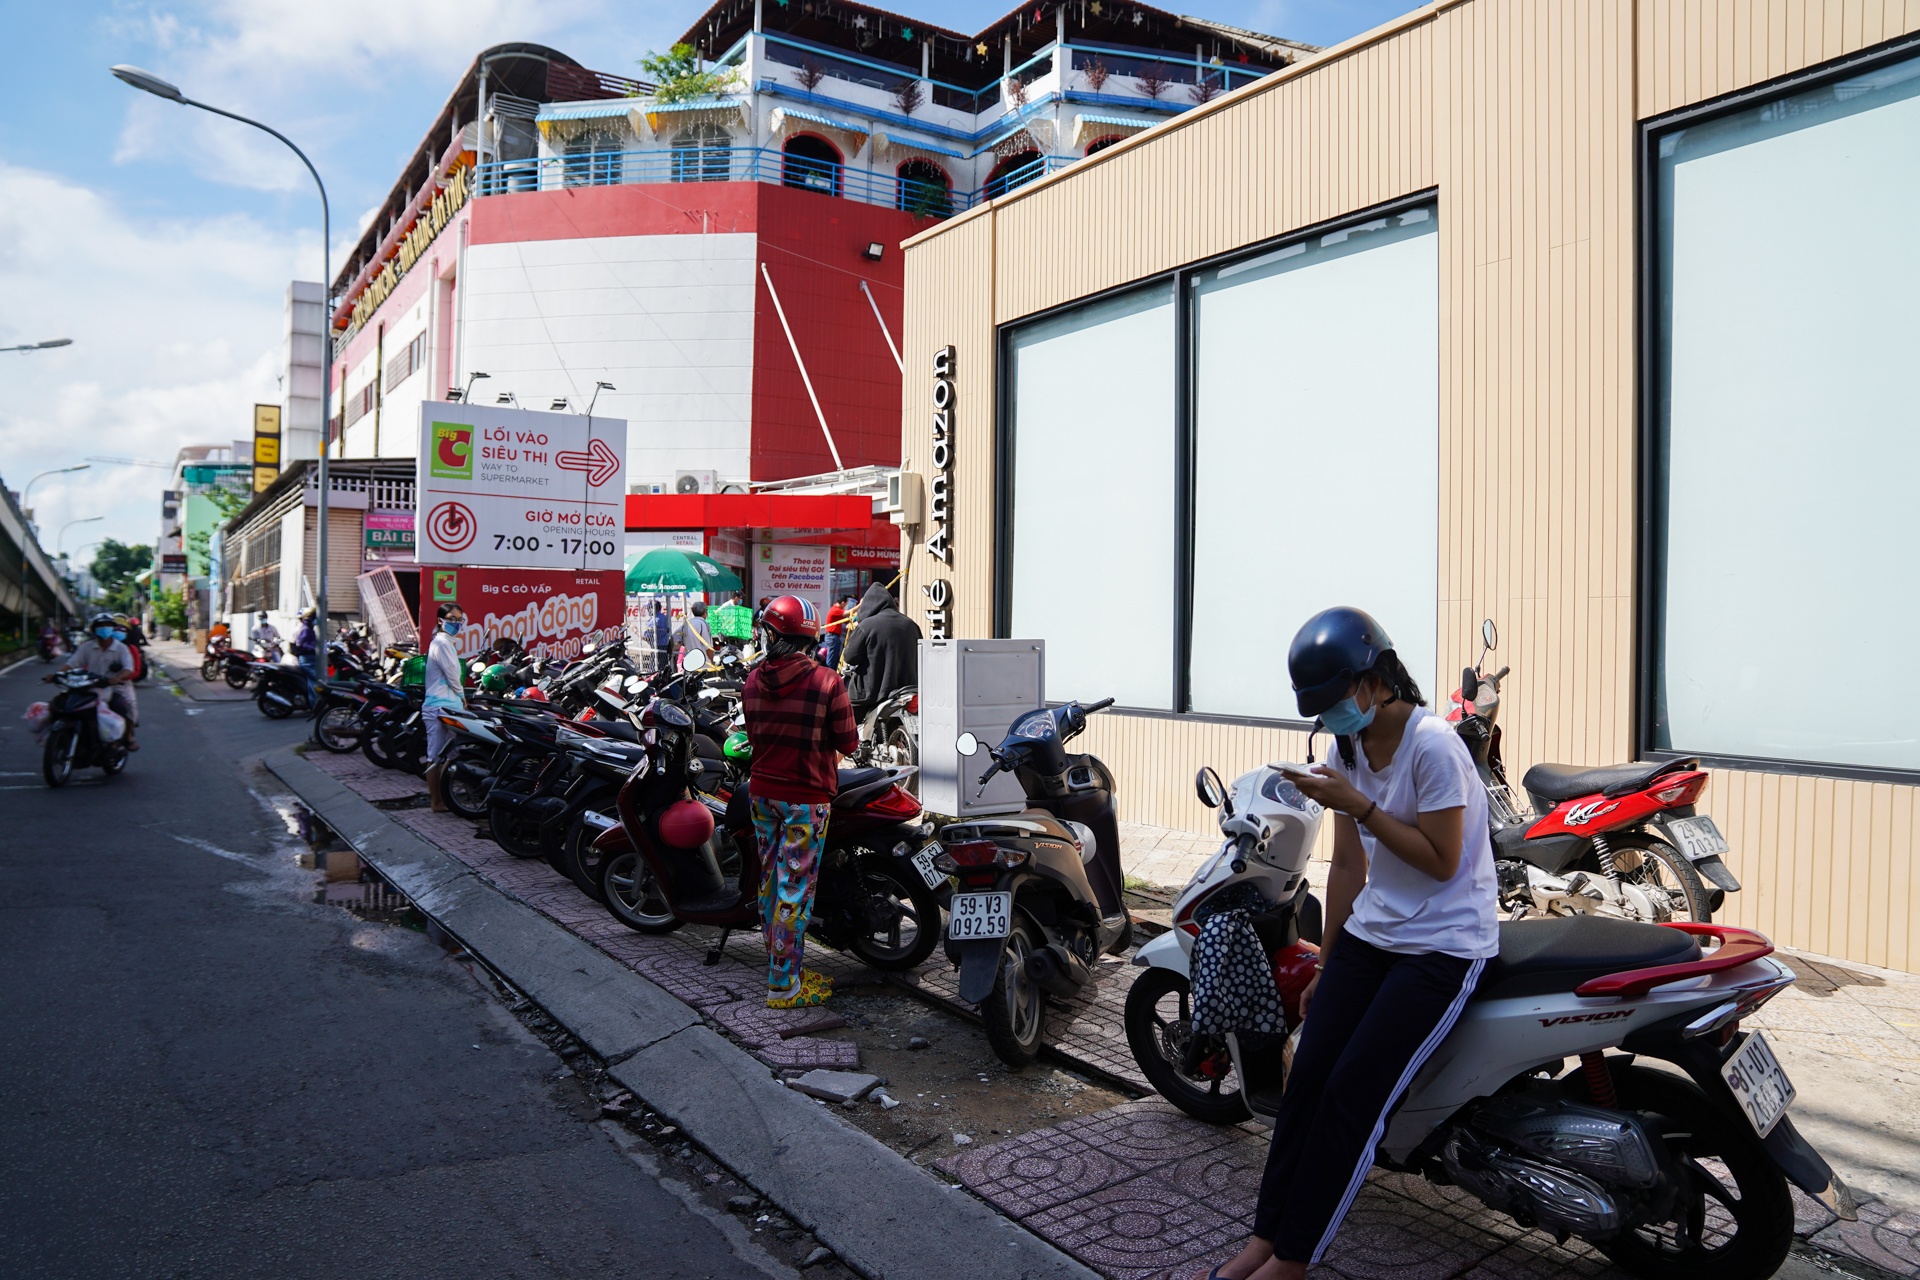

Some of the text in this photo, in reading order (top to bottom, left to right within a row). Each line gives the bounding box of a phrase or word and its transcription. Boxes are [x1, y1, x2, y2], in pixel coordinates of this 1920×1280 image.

[437, 428, 457, 442] Big
[484, 426, 549, 446] LỐI VÀO
[481, 445, 548, 466] SIÊU THỊ
[925, 344, 954, 563] Amazon
[481, 463, 518, 473] WAY TO
[480, 473, 550, 486] SUPERMARKET
[525, 509, 616, 527] GIỜ MỞ CỬA
[372, 529, 397, 542] BÃI
[543, 525, 616, 537] OPENING HOURS
[493, 534, 540, 552] 7:00
[560, 538, 616, 556] 17:00
[851, 548, 876, 558] CHÀO
[482, 583, 552, 594] Big C GÒ VẤP
[787, 582, 803, 590] Việt
[541, 598, 594, 634] động
[1678, 819, 1712, 839] 29-V5
[1688, 836, 1723, 856] 2032
[960, 895, 1002, 915] 59-V3
[953, 915, 1006, 936] 092.59
[1537, 1008, 1636, 1028] VISION
[1731, 1041, 1770, 1094] 81-U1
